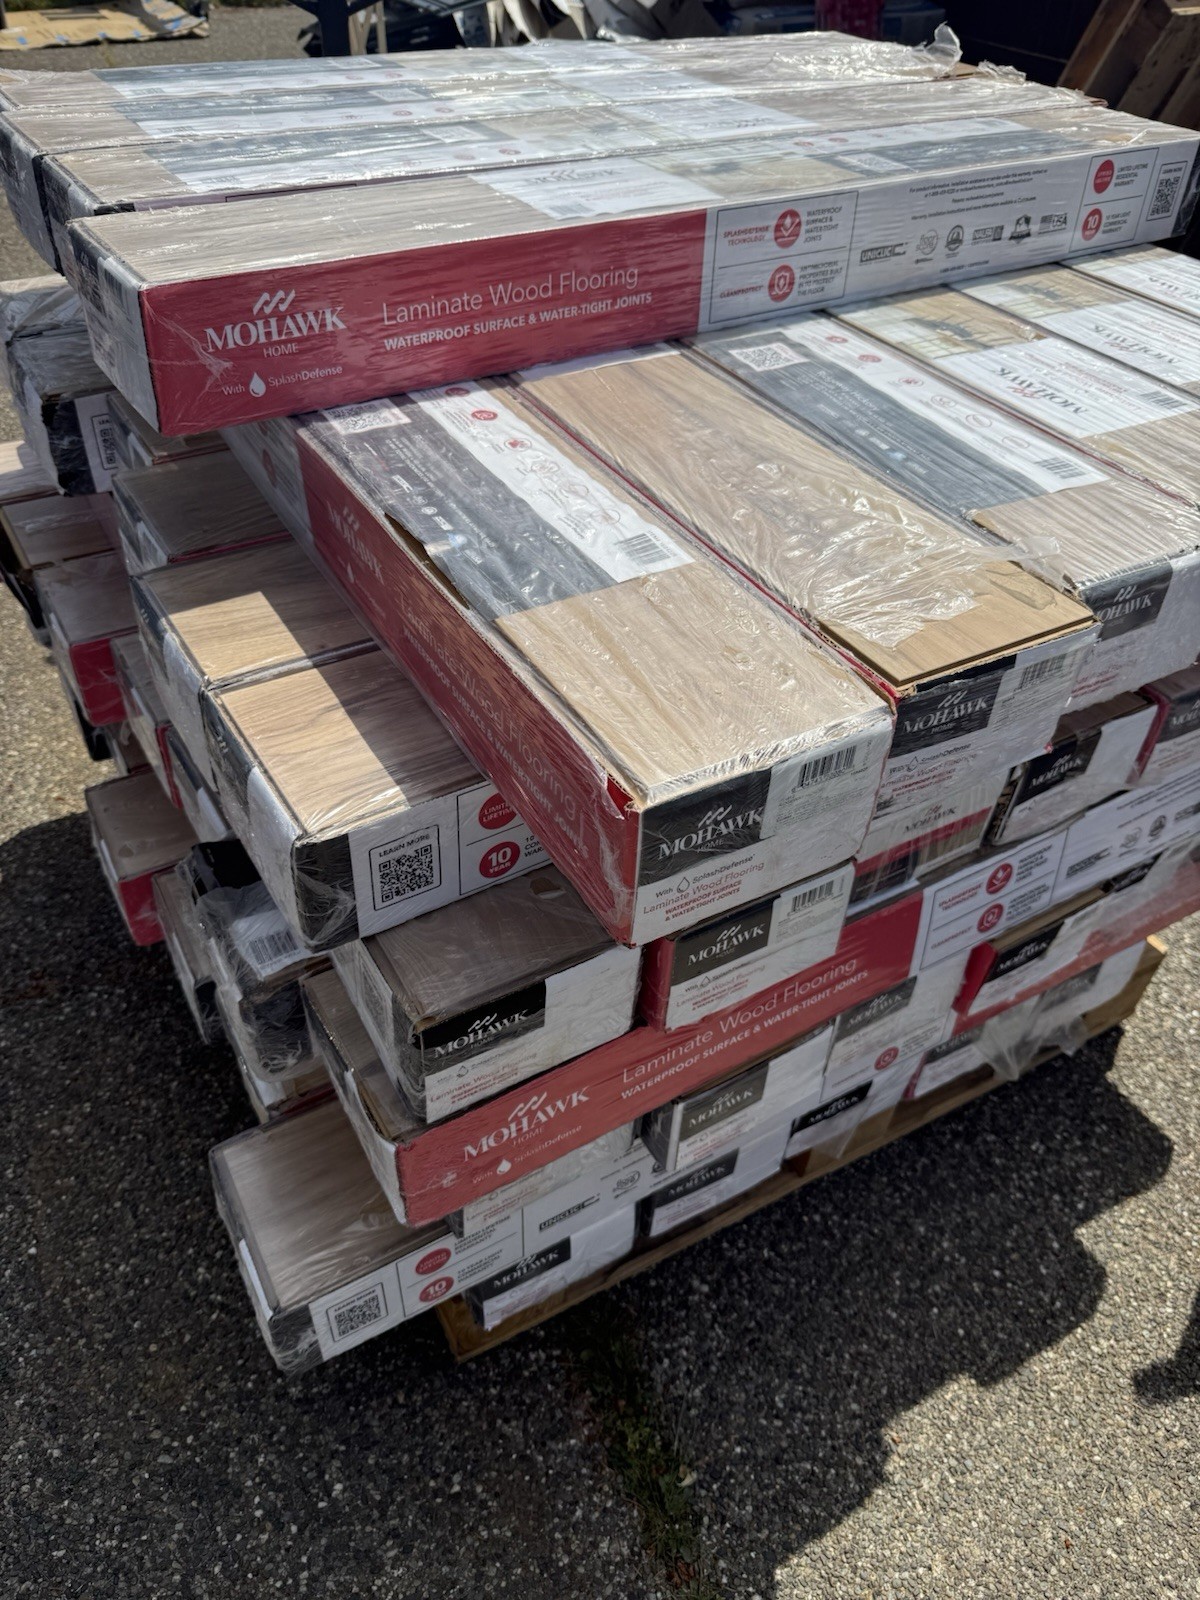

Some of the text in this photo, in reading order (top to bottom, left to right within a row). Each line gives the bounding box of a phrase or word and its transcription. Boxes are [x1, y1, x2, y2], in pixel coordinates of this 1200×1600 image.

[727, 234, 766, 246] TECHNOLOGY
[1087, 215, 1099, 230] 10
[383, 266, 639, 326] Laminate Wood Flooring
[204, 306, 347, 353] MOHAWK
[384, 292, 652, 351] WATERPROOF SURFACE & WATER-TIGHT JOINTS
[263, 343, 299, 359] HOME
[221, 365, 343, 396] With SplashDefense
[992, 367, 1088, 414] MOHAWK
[1097, 592, 1155, 622] OHAWK
[451, 685, 486, 732] SURFACE
[902, 695, 989, 735] MOHAWK
[484, 801, 508, 815] LIMIT
[379, 833, 431, 858] LEARN MORE
[658, 807, 764, 860] MOHAWK
[488, 847, 512, 868] 10
[489, 862, 512, 874] YEAR
[655, 854, 756, 899] With SplashDefense
[643, 862, 765, 915] Laminate Wood Flooring
[665, 880, 742, 915] WATERPROOF SURFACE
[672, 899, 716, 919] WATER-TIGHT
[716, 887, 741, 901] JOINTS
[687, 923, 766, 967] MOHAWK
[434, 1009, 529, 1059] MOHAWK
[620, 969, 869, 1101] WATERPROOF SURFACE & WATER-TIGHT JOINTS
[623, 958, 858, 1084] Laminate Wood Flooring
[470, 1036, 495, 1049] HOME
[430, 1083, 471, 1103] Laminate
[473, 1068, 502, 1083] Wood
[463, 1085, 592, 1162] MOHAWK
[689, 1088, 754, 1128] MOHAWK
[472, 1171, 494, 1184] With
[514, 1124, 583, 1163] SplashDefense
[512, 1126, 545, 1147] HOME
[426, 1280, 447, 1296] 10
[493, 1250, 559, 1289] MOHAWK
